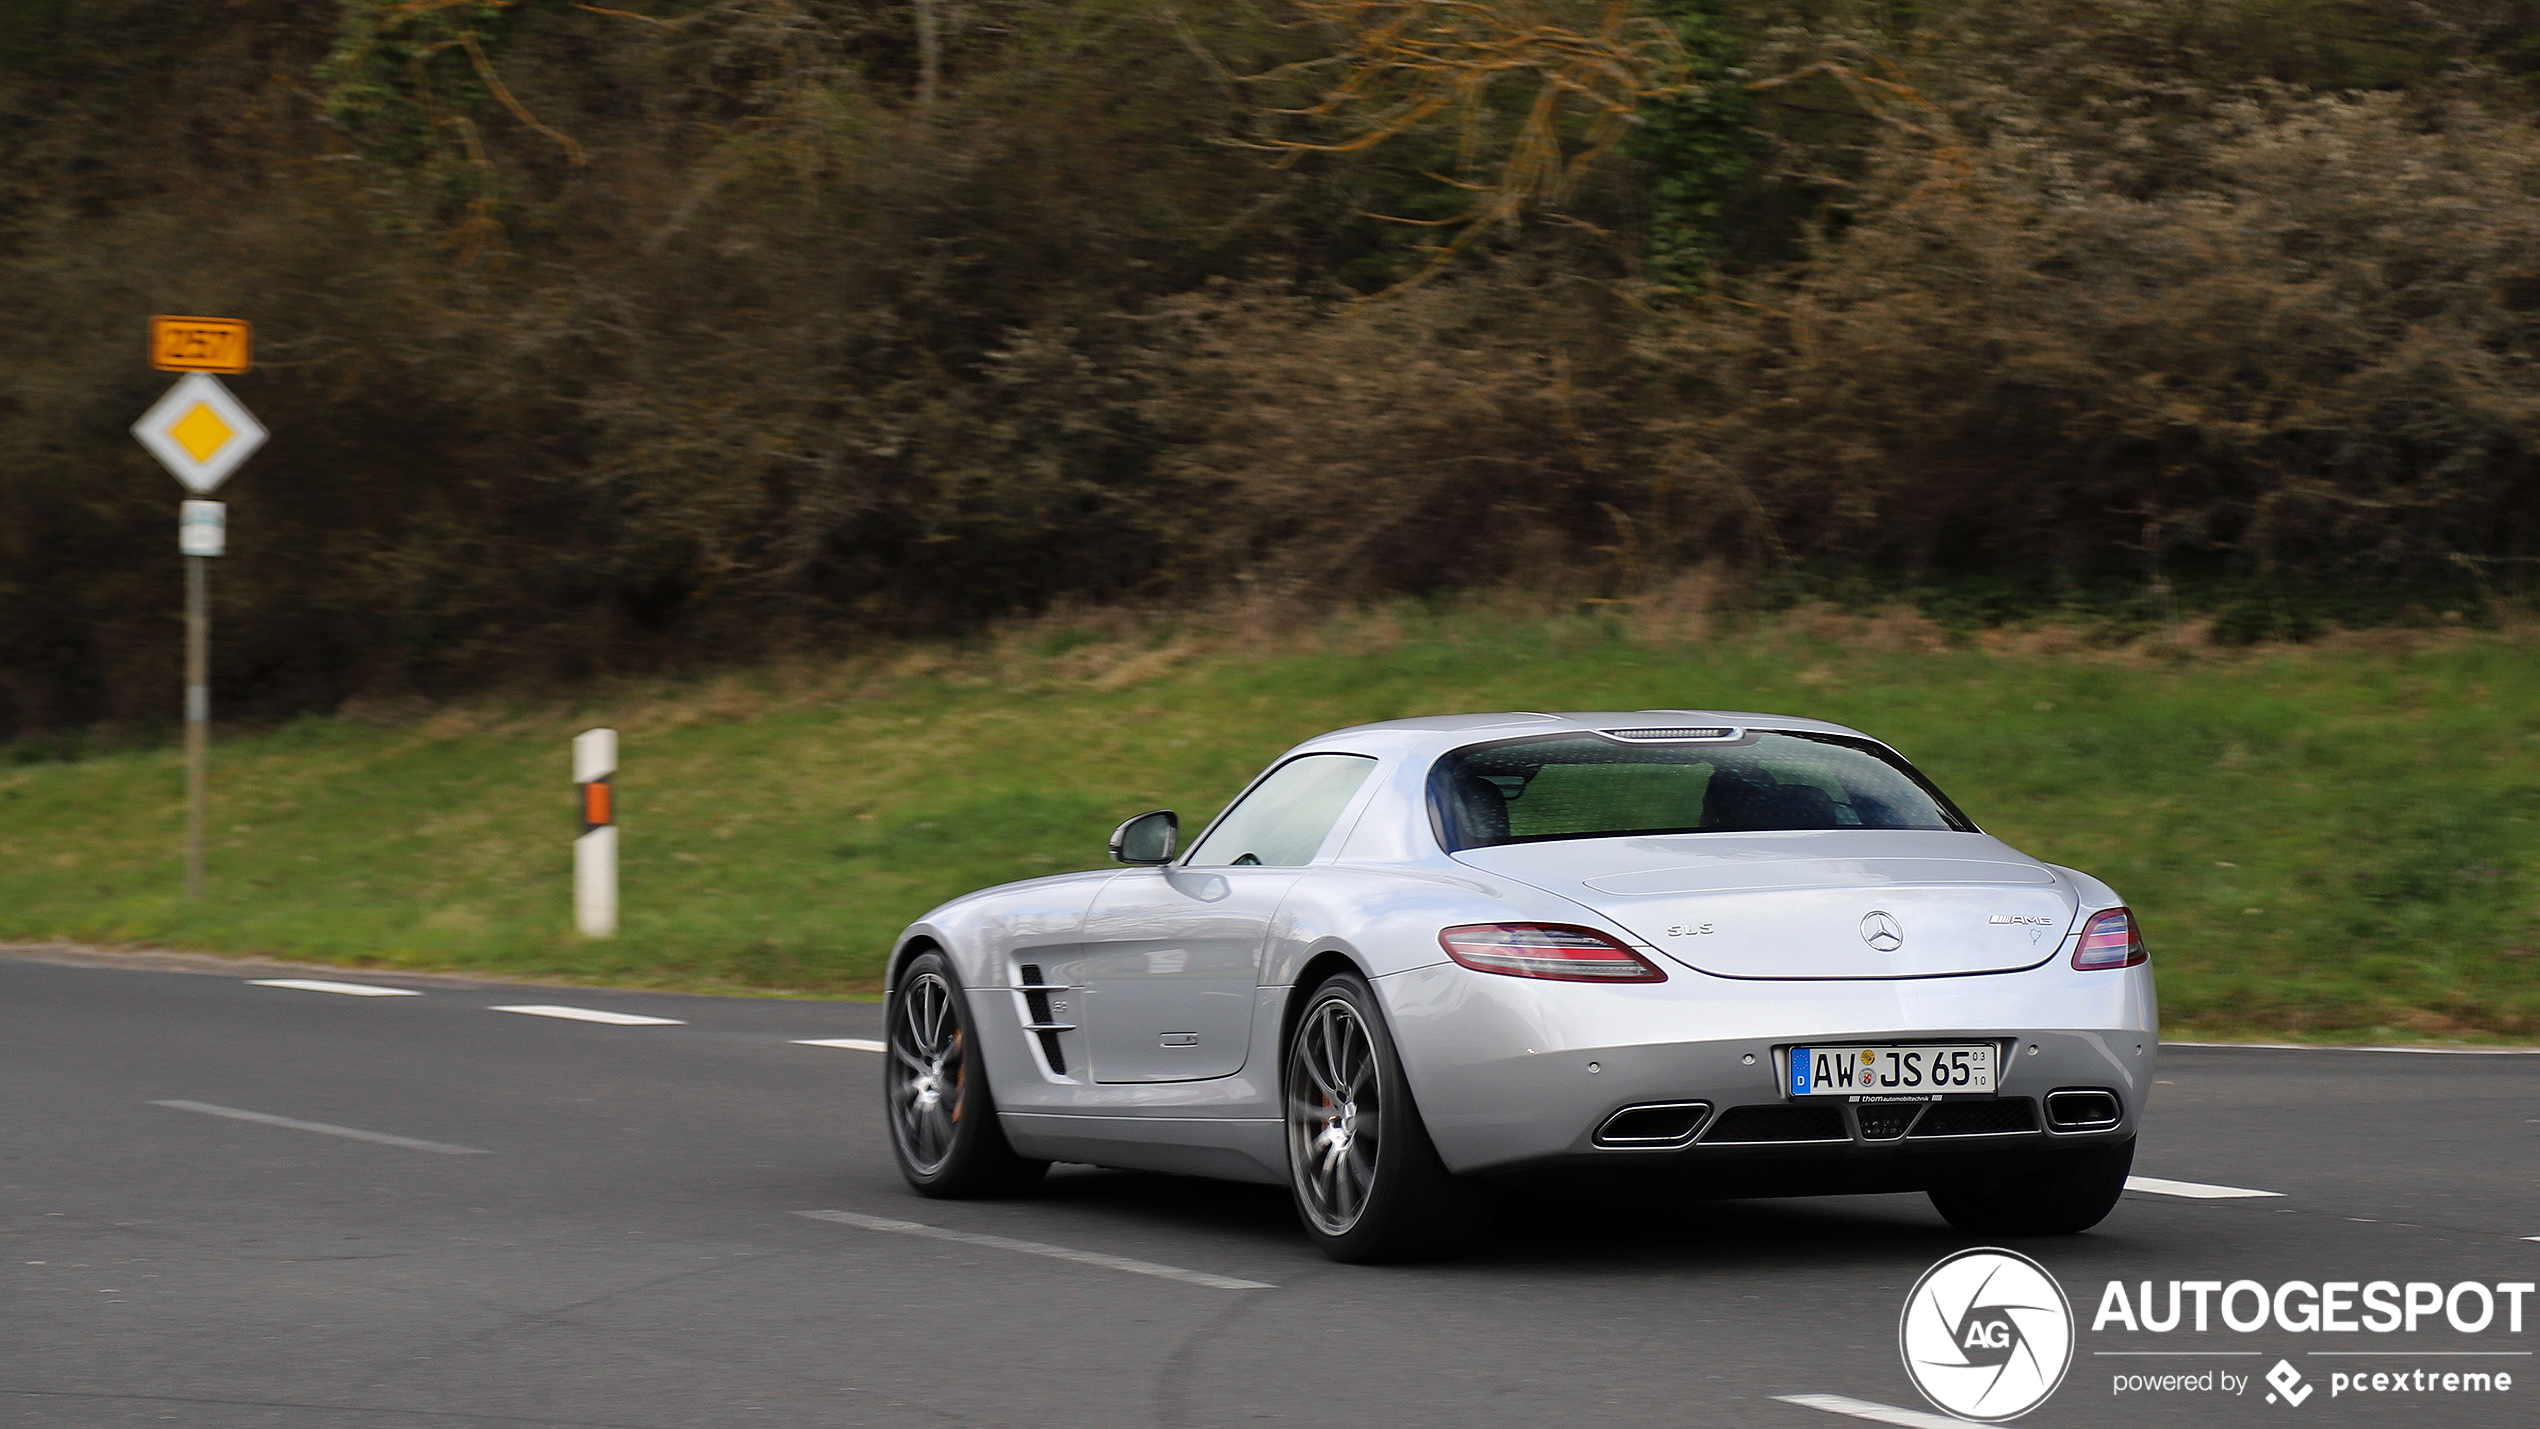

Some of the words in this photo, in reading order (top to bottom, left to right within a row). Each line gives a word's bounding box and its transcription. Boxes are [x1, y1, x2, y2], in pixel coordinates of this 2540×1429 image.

[2009, 915, 2054, 926] AMG
[1666, 923, 1714, 938] SLS
[1972, 1051, 1986, 1061] 03
[1813, 1053, 1856, 1088] AW
[1880, 1052, 1923, 1087] JS
[1931, 1051, 1970, 1086] 65
[1797, 1075, 1805, 1086] D
[1974, 1075, 1987, 1086] 10
